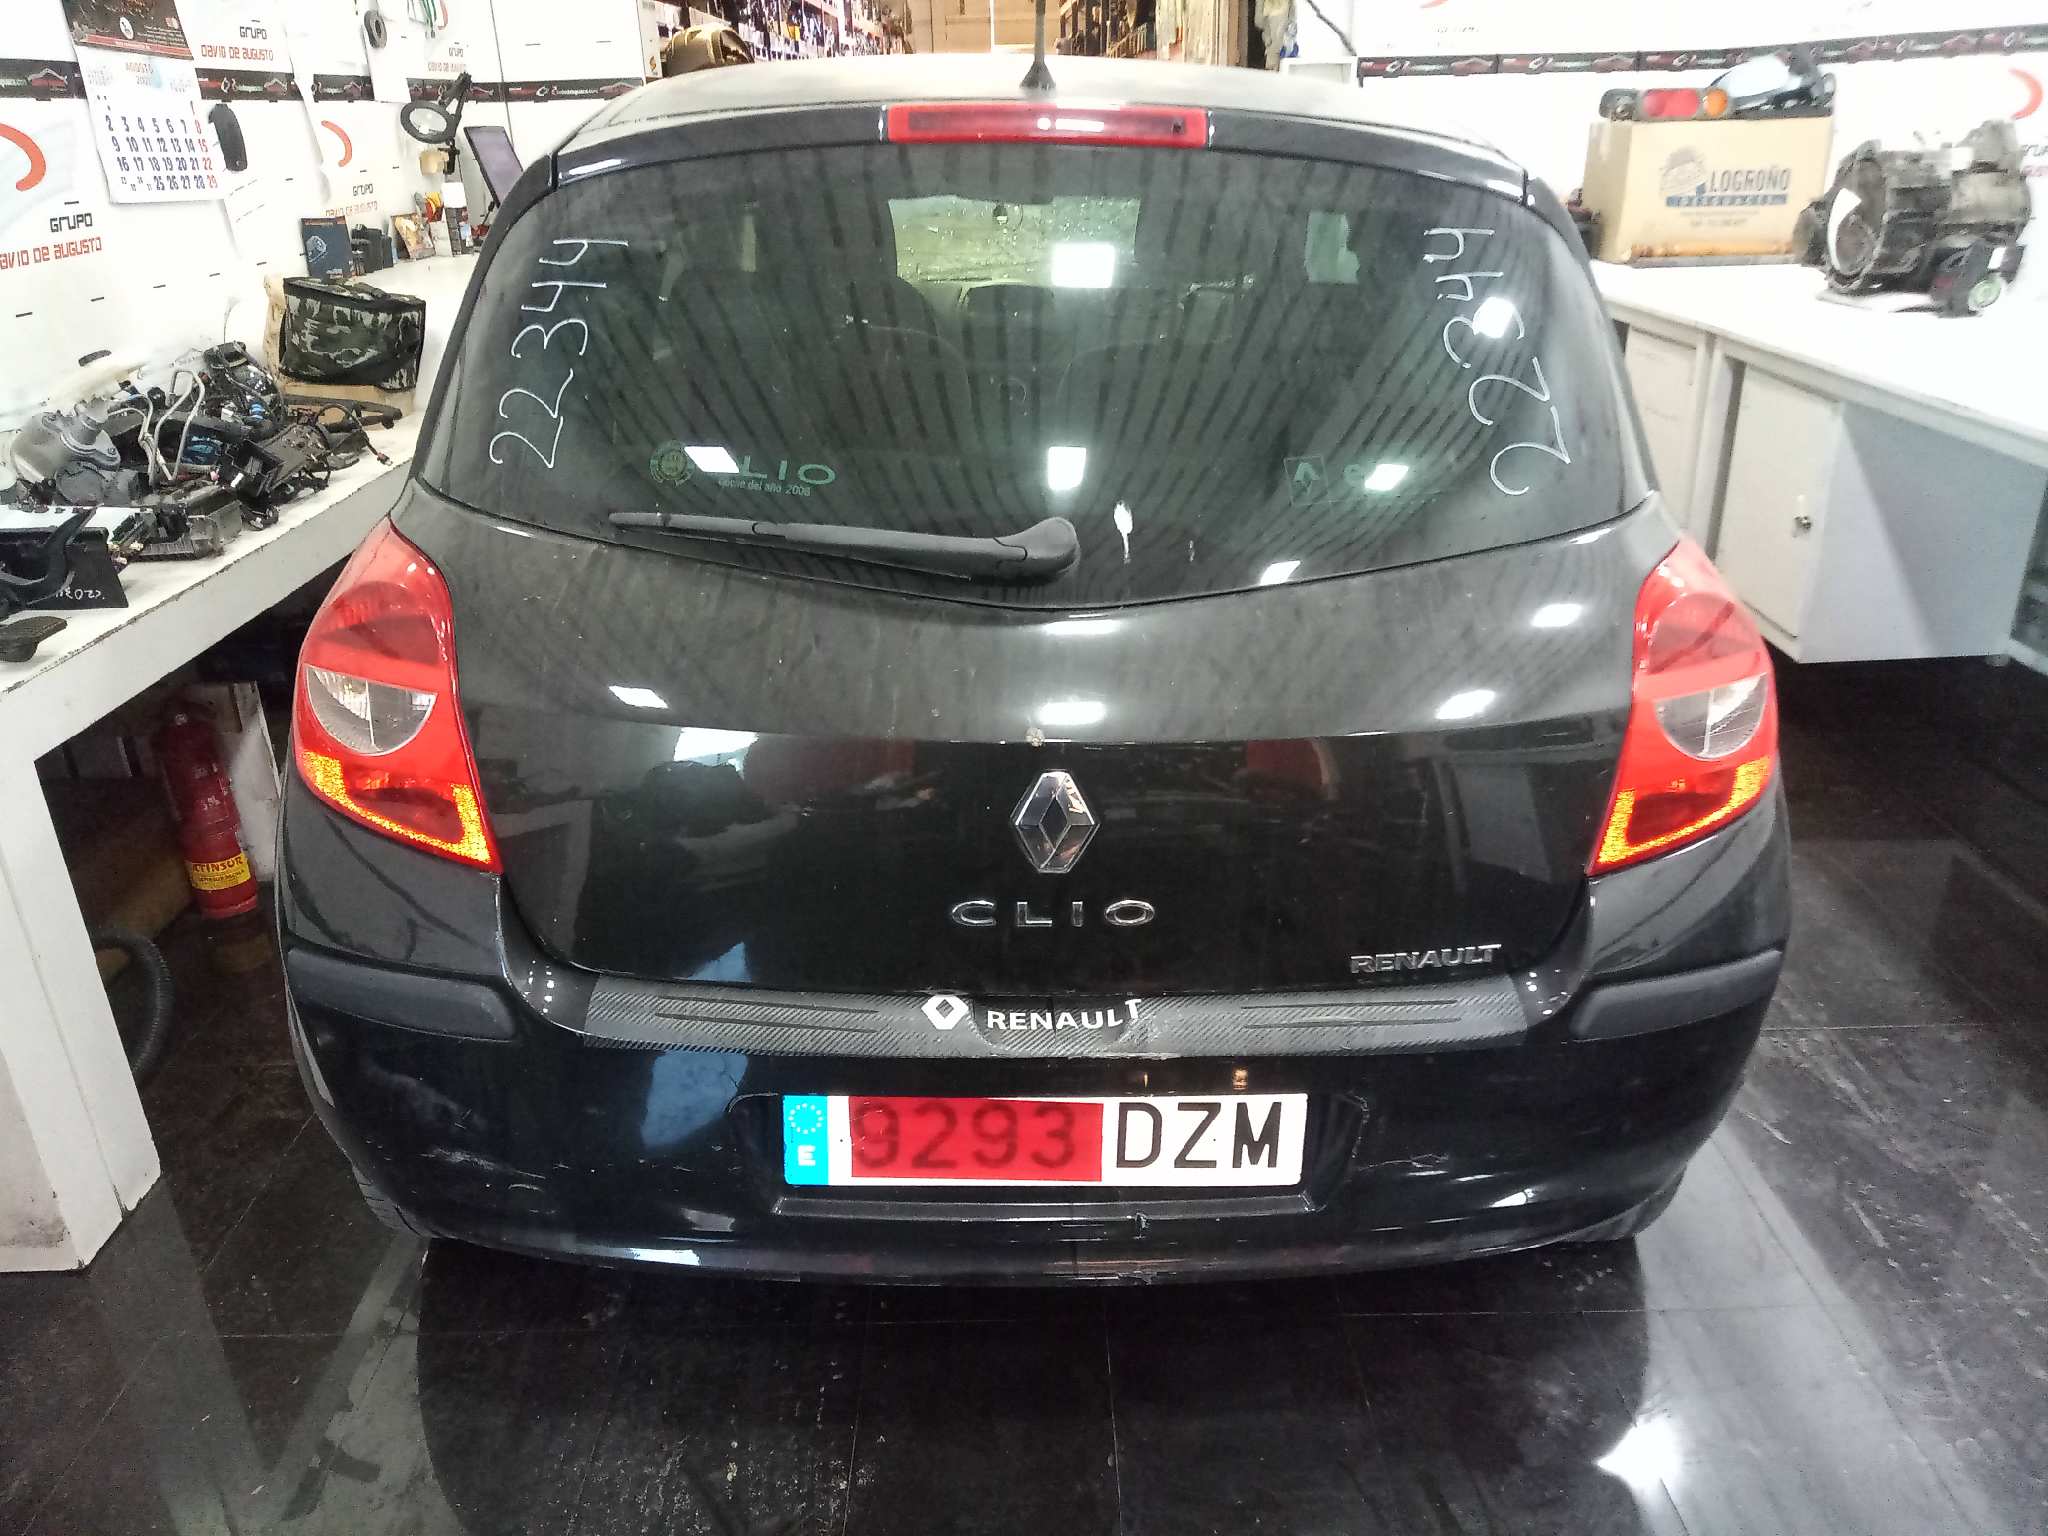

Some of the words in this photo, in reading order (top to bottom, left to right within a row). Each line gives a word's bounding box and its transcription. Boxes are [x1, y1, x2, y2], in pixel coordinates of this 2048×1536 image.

[105, 115, 114, 132] 2
[121, 116, 130, 132] 3
[137, 117, 145, 133] 4
[152, 118, 160, 133] 5
[166, 118, 174, 133] 6
[180, 119, 188, 134] 7
[194, 120, 202, 134] 8
[111, 136, 121, 152] 9
[126, 137, 139, 152] 10
[142, 137, 154, 152] 11
[156, 137, 168, 153] 12
[170, 137, 182, 152] 13
[184, 138, 196, 152] 14
[198, 139, 208, 152] 15
[116, 156, 130, 171] 16
[133, 157, 145, 171] 17
[148, 157, 161, 171] 18
[162, 157, 174, 171] 19
[175, 157, 188, 171] 20
[189, 157, 200, 171] 21
[202, 157, 213, 171] 22
[154, 175, 166, 191] 25
[166, 175, 179, 190] 26
[180, 175, 192, 190] 27
[193, 175, 205, 190] 28
[206, 175, 218, 189] 29
[49, 212, 93, 233] GRUPO
[951, 899, 1156, 928] CLIO
[1350, 943, 1502, 974] RENAULT
[987, 998, 1142, 1030] RENAULT
[852, 1103, 1076, 1169] 9293
[1115, 1101, 1283, 1169] DZM
[797, 1144, 816, 1167] E
